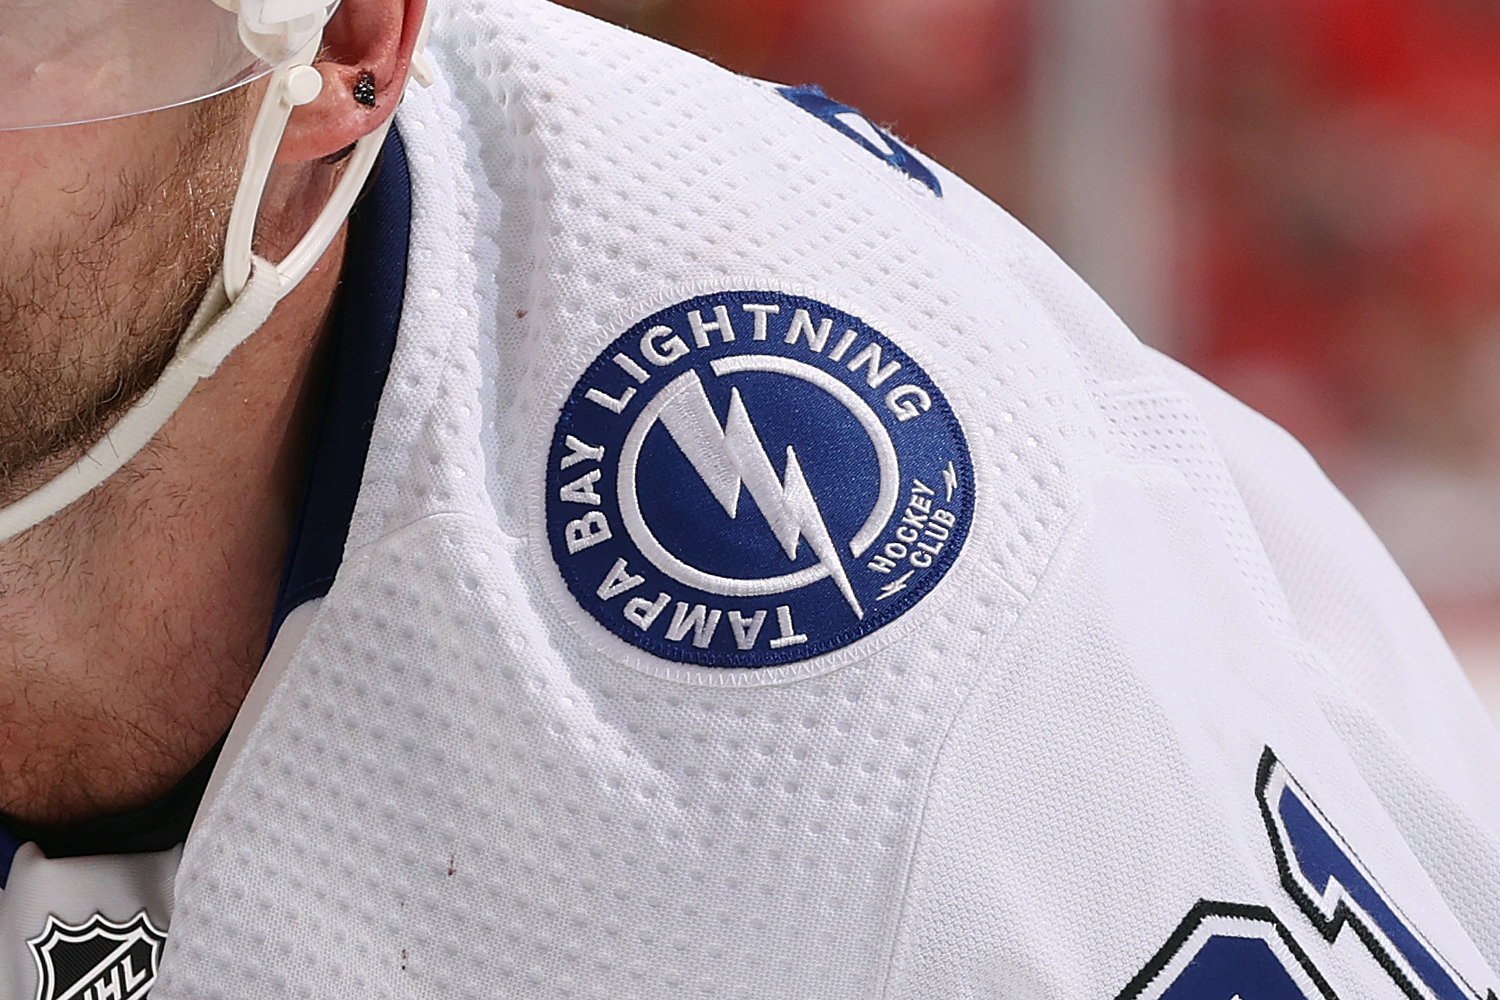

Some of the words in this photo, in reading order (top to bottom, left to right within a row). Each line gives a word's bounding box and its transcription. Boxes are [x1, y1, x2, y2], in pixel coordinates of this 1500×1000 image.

[585, 303, 933, 423] LIGHTNING
[560, 434, 612, 554] BAY
[867, 479, 935, 573] HOCKEY
[909, 509, 956, 568] CLUB
[596, 557, 808, 650] TAMPA
